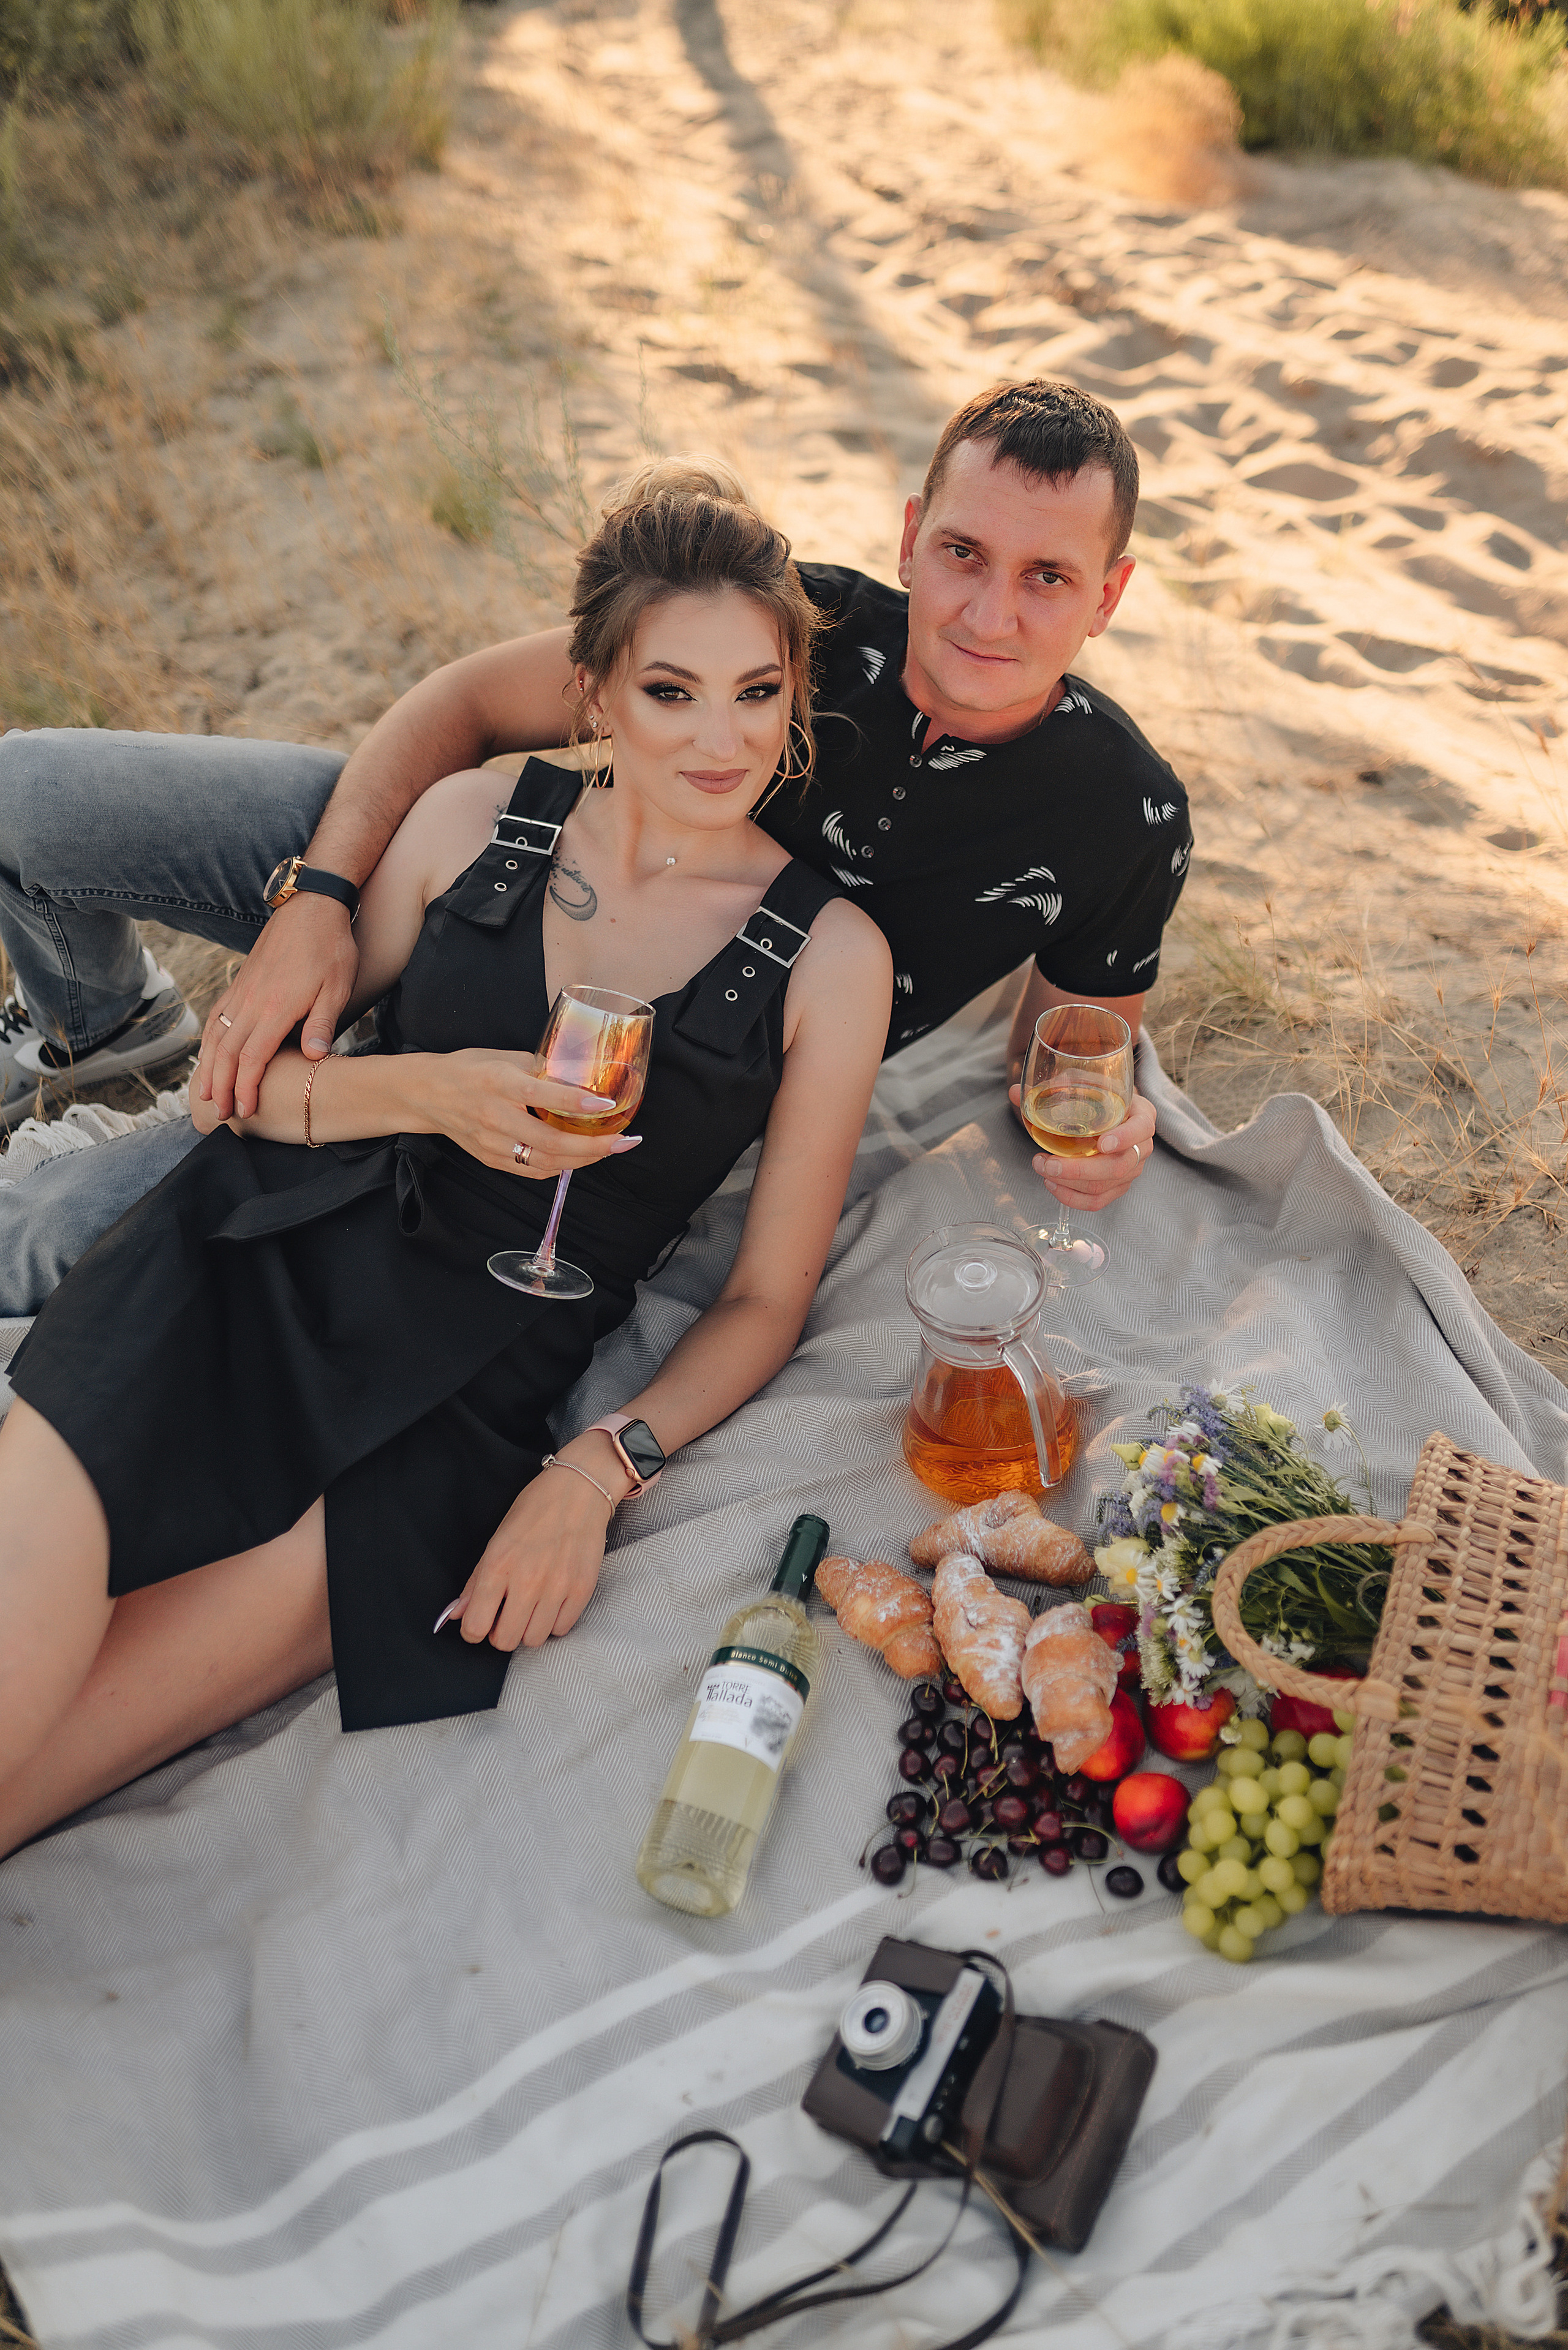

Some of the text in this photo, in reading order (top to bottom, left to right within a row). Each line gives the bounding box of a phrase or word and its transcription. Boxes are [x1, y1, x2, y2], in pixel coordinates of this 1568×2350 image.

[731, 1650, 756, 1662] Blanco
[759, 1655, 778, 1669] Semi
[706, 1684, 753, 1708] Tallada
[721, 1681, 752, 1695] TORRE
